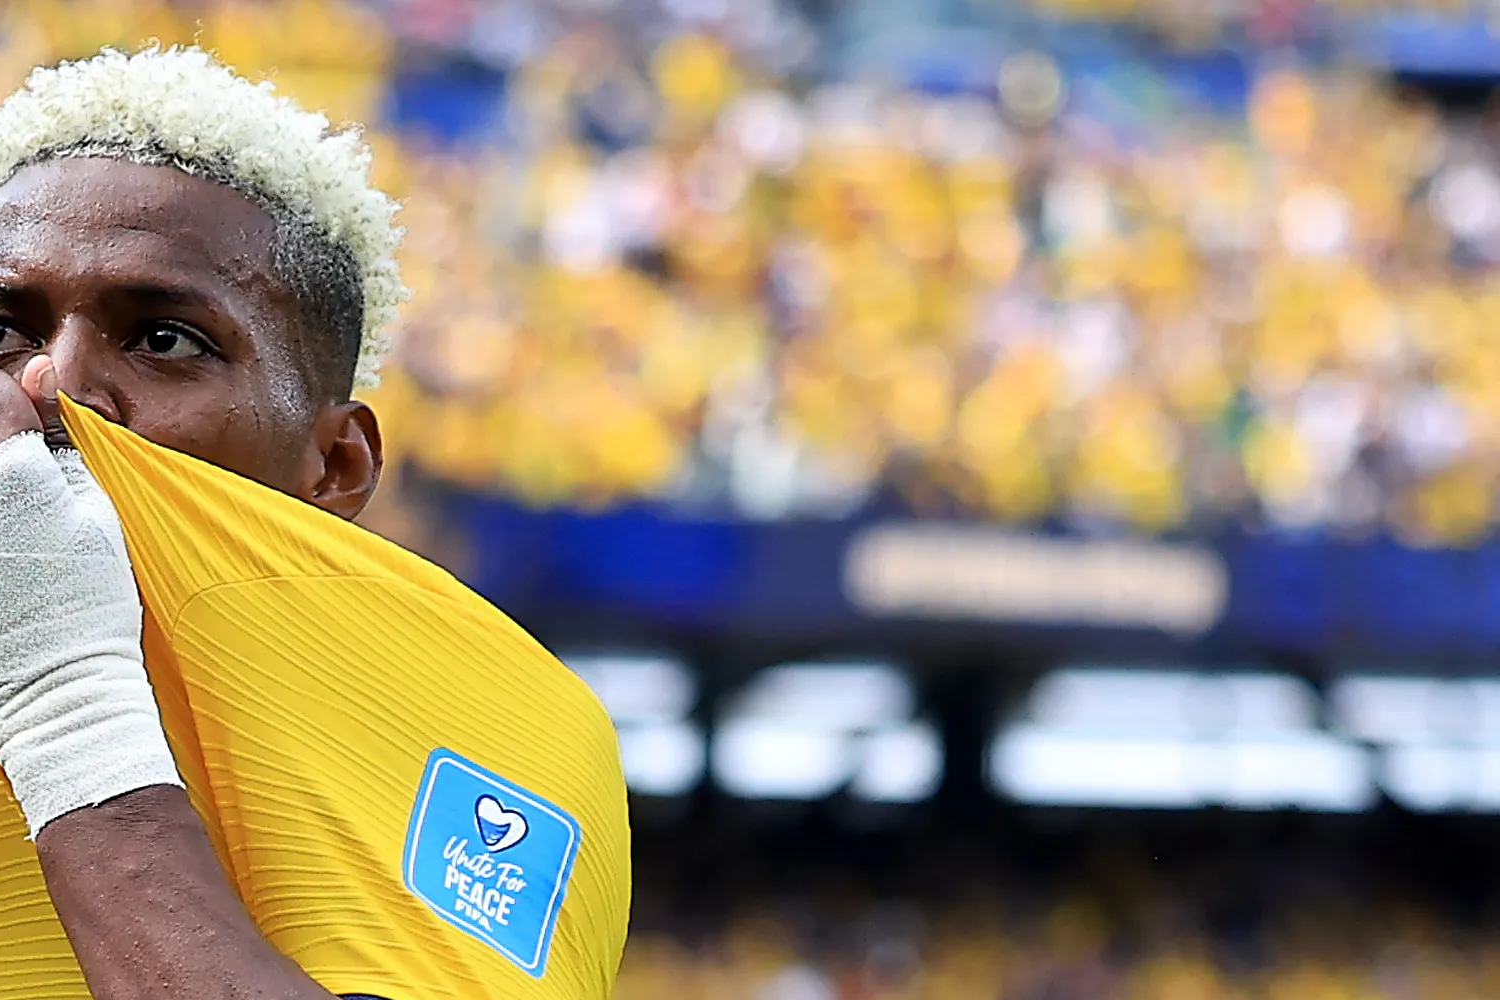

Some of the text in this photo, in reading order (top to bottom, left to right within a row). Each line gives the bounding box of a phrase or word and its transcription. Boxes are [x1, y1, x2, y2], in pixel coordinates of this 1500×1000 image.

[443, 836, 527, 892] Unite For
[444, 864, 515, 926] PEACE
